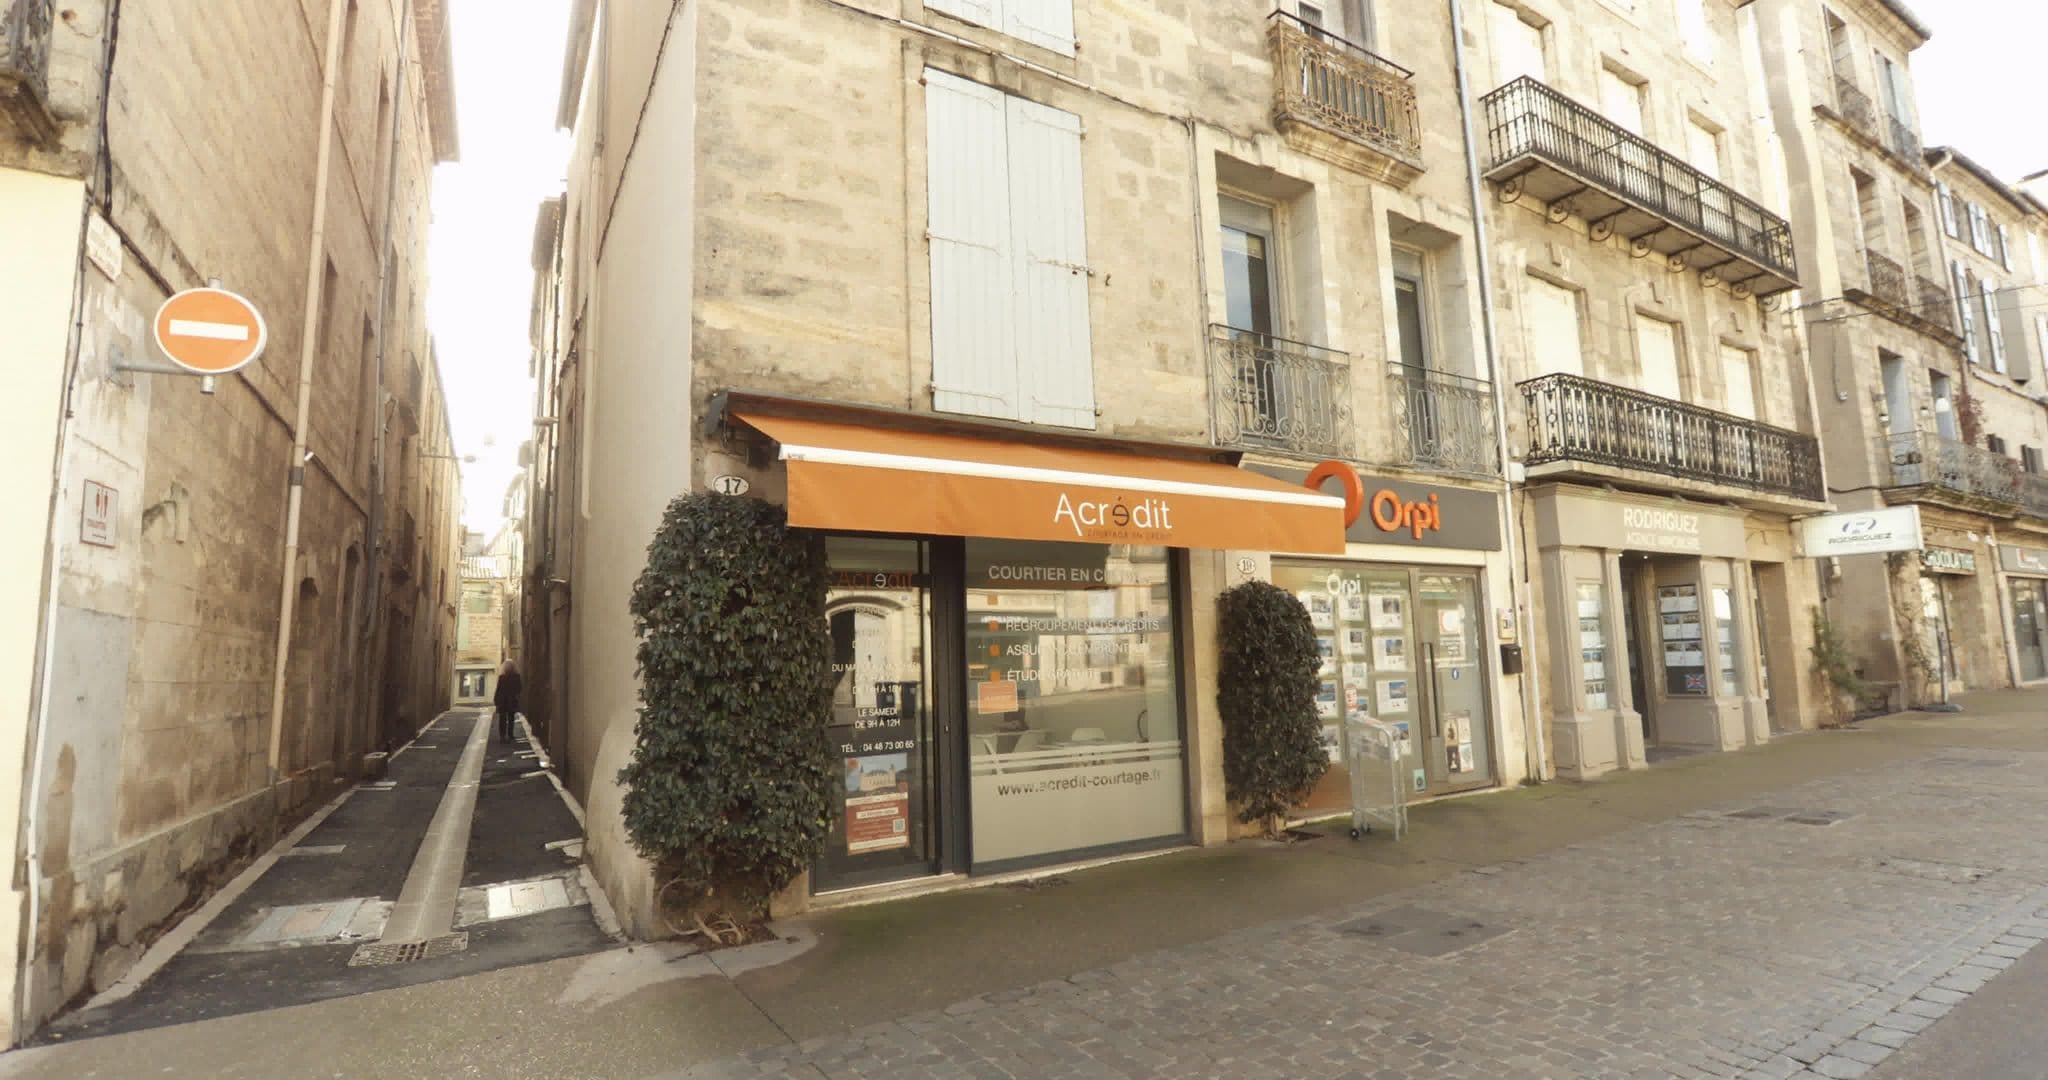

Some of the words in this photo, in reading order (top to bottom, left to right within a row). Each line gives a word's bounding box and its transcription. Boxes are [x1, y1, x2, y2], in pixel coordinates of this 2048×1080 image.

[724, 477, 742, 496] 17
[1053, 492, 1173, 537] Acrédit
[1371, 489, 1441, 540] Orpi
[1623, 507, 1699, 534] RODRIGUEZ
[1828, 532, 1892, 545] RODRIGUEZ
[988, 565, 1066, 581] COURTIER
[1070, 568, 1090, 582] EN
[1326, 573, 1361, 597] Orpi
[857, 709, 866, 717] LE
[868, 707, 898, 717] SAMEDI
[854, 720, 866, 729] DE
[886, 718, 901, 727] 12H
[862, 743, 873, 752] 04
[874, 742, 883, 751] 48
[884, 741, 894, 750] 73
